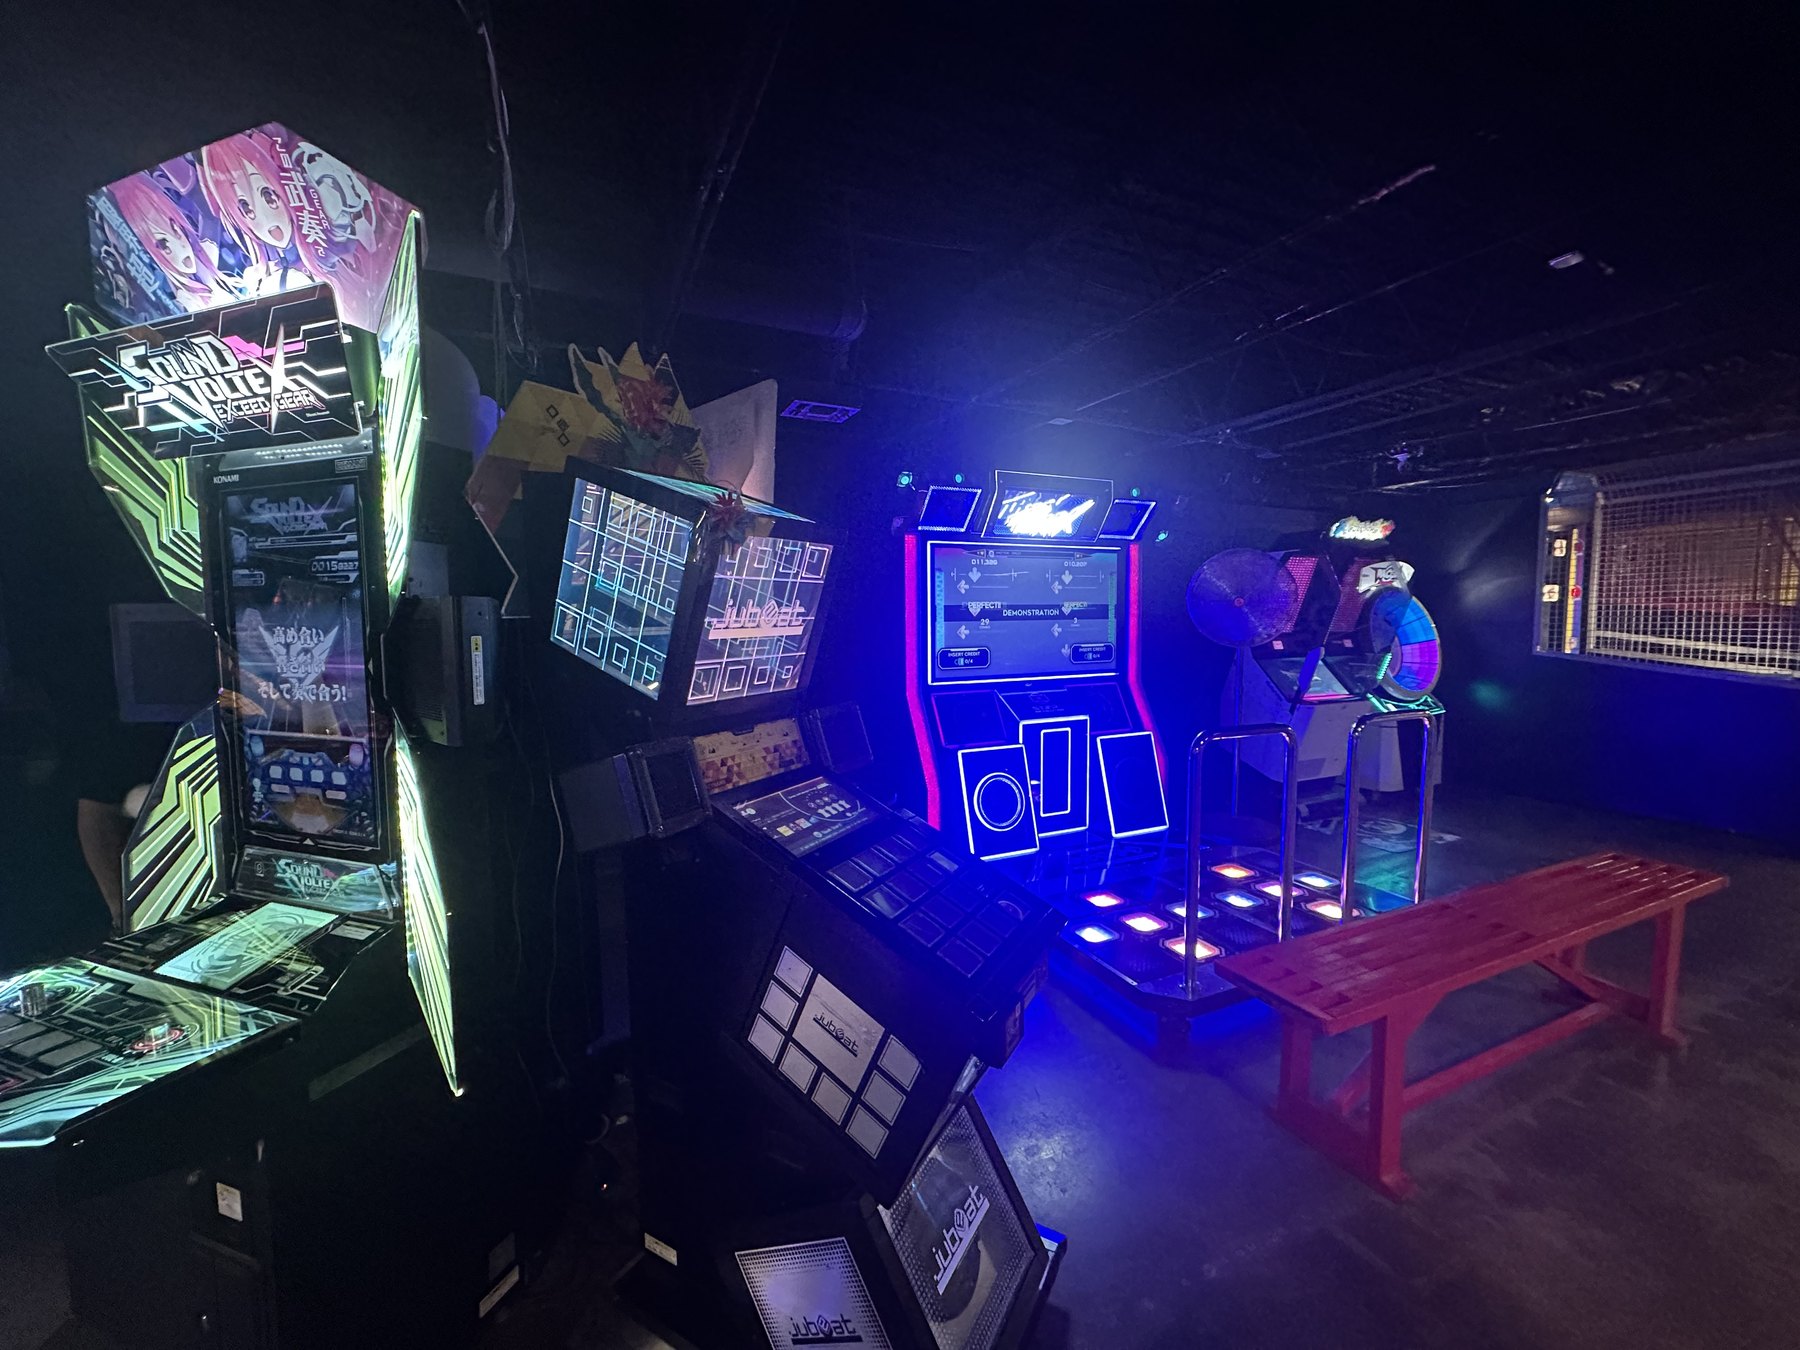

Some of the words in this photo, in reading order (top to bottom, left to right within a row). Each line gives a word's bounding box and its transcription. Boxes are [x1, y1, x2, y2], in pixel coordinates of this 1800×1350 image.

[308, 188, 331, 230] GEAR
[116, 334, 241, 387] SOUND
[214, 396, 271, 423] EXCEED
[273, 387, 326, 413] GEAR
[213, 474, 240, 485] KONAMI
[712, 599, 806, 629] jubeat
[980, 618, 990, 626] 29
[1002, 609, 1060, 617] DEMONSTRATION
[277, 858, 322, 878] SOUND
[813, 1012, 859, 1054] jubeat
[933, 1184, 985, 1283] jubeat
[790, 1312, 856, 1341] jubeat
